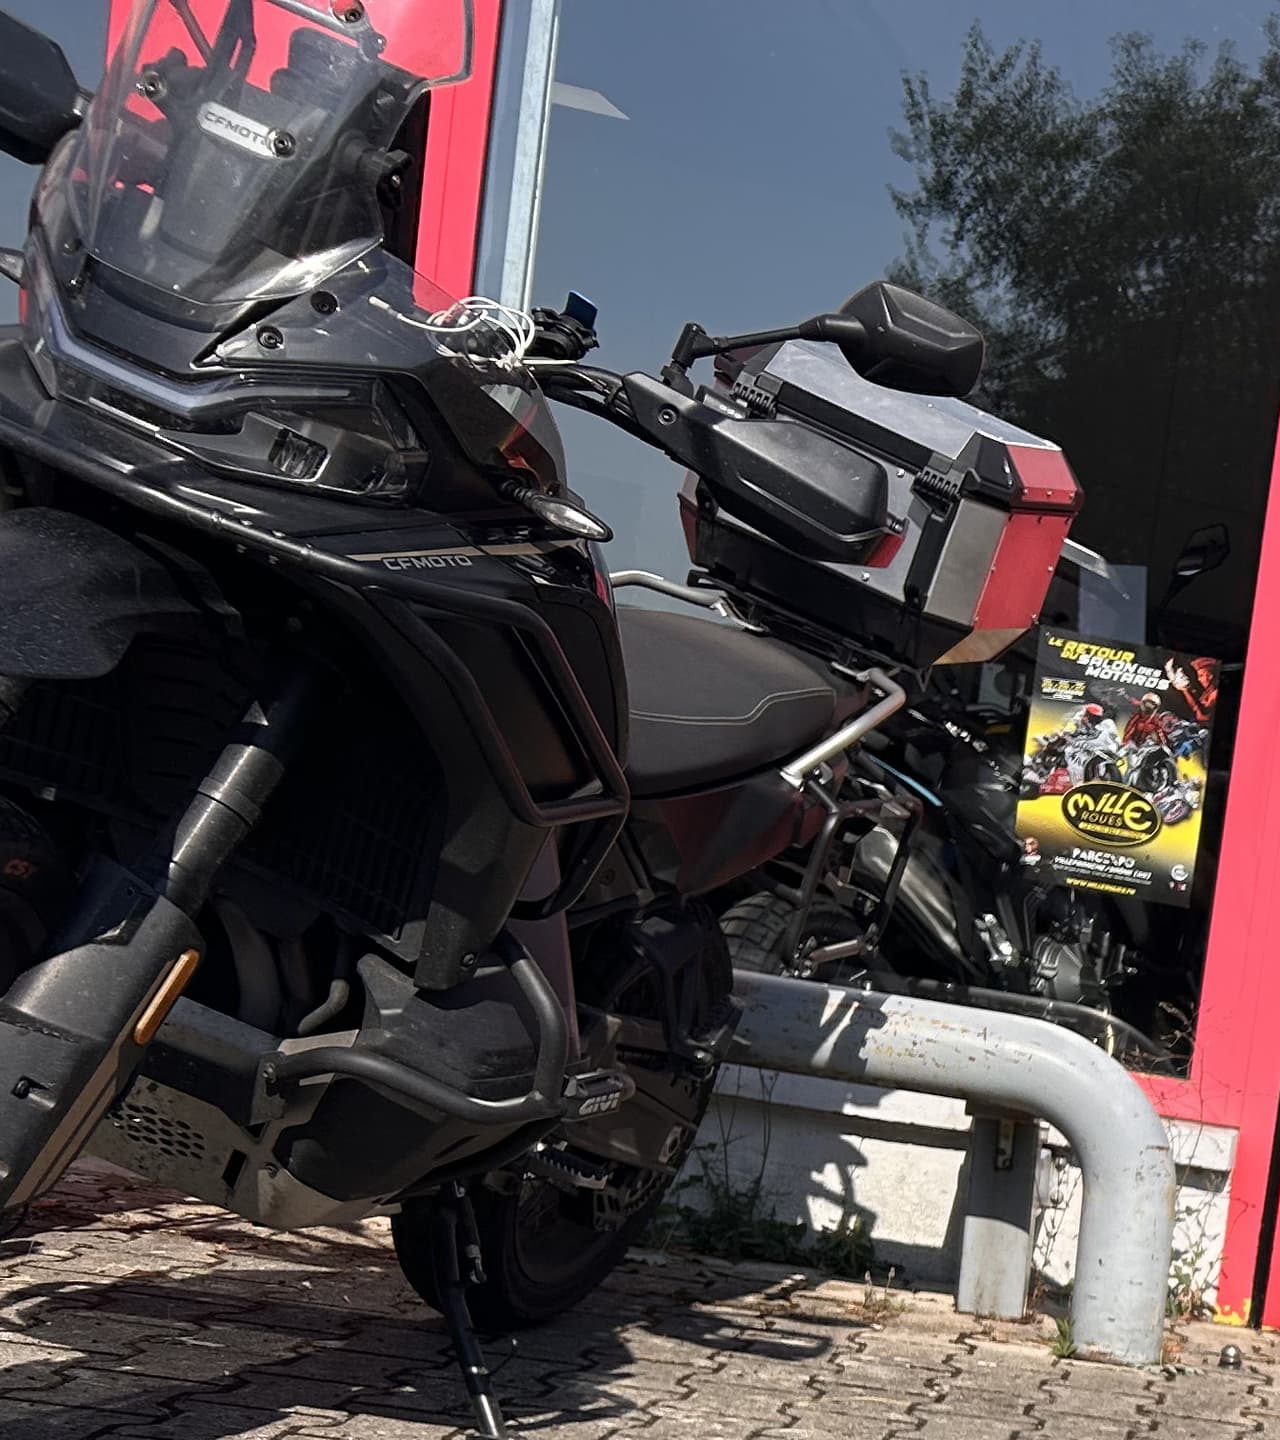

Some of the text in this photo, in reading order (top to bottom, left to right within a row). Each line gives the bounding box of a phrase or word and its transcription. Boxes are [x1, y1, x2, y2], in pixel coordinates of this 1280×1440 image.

[383, 555, 473, 571] CFMOTO
[1047, 636, 1136, 663] LE RETOUR
[1076, 654, 1139, 674] SALON
[1084, 666, 1171, 690] MOTARDS
[1067, 791, 1152, 831] MILLE
[1080, 811, 1123, 828] ROUES
